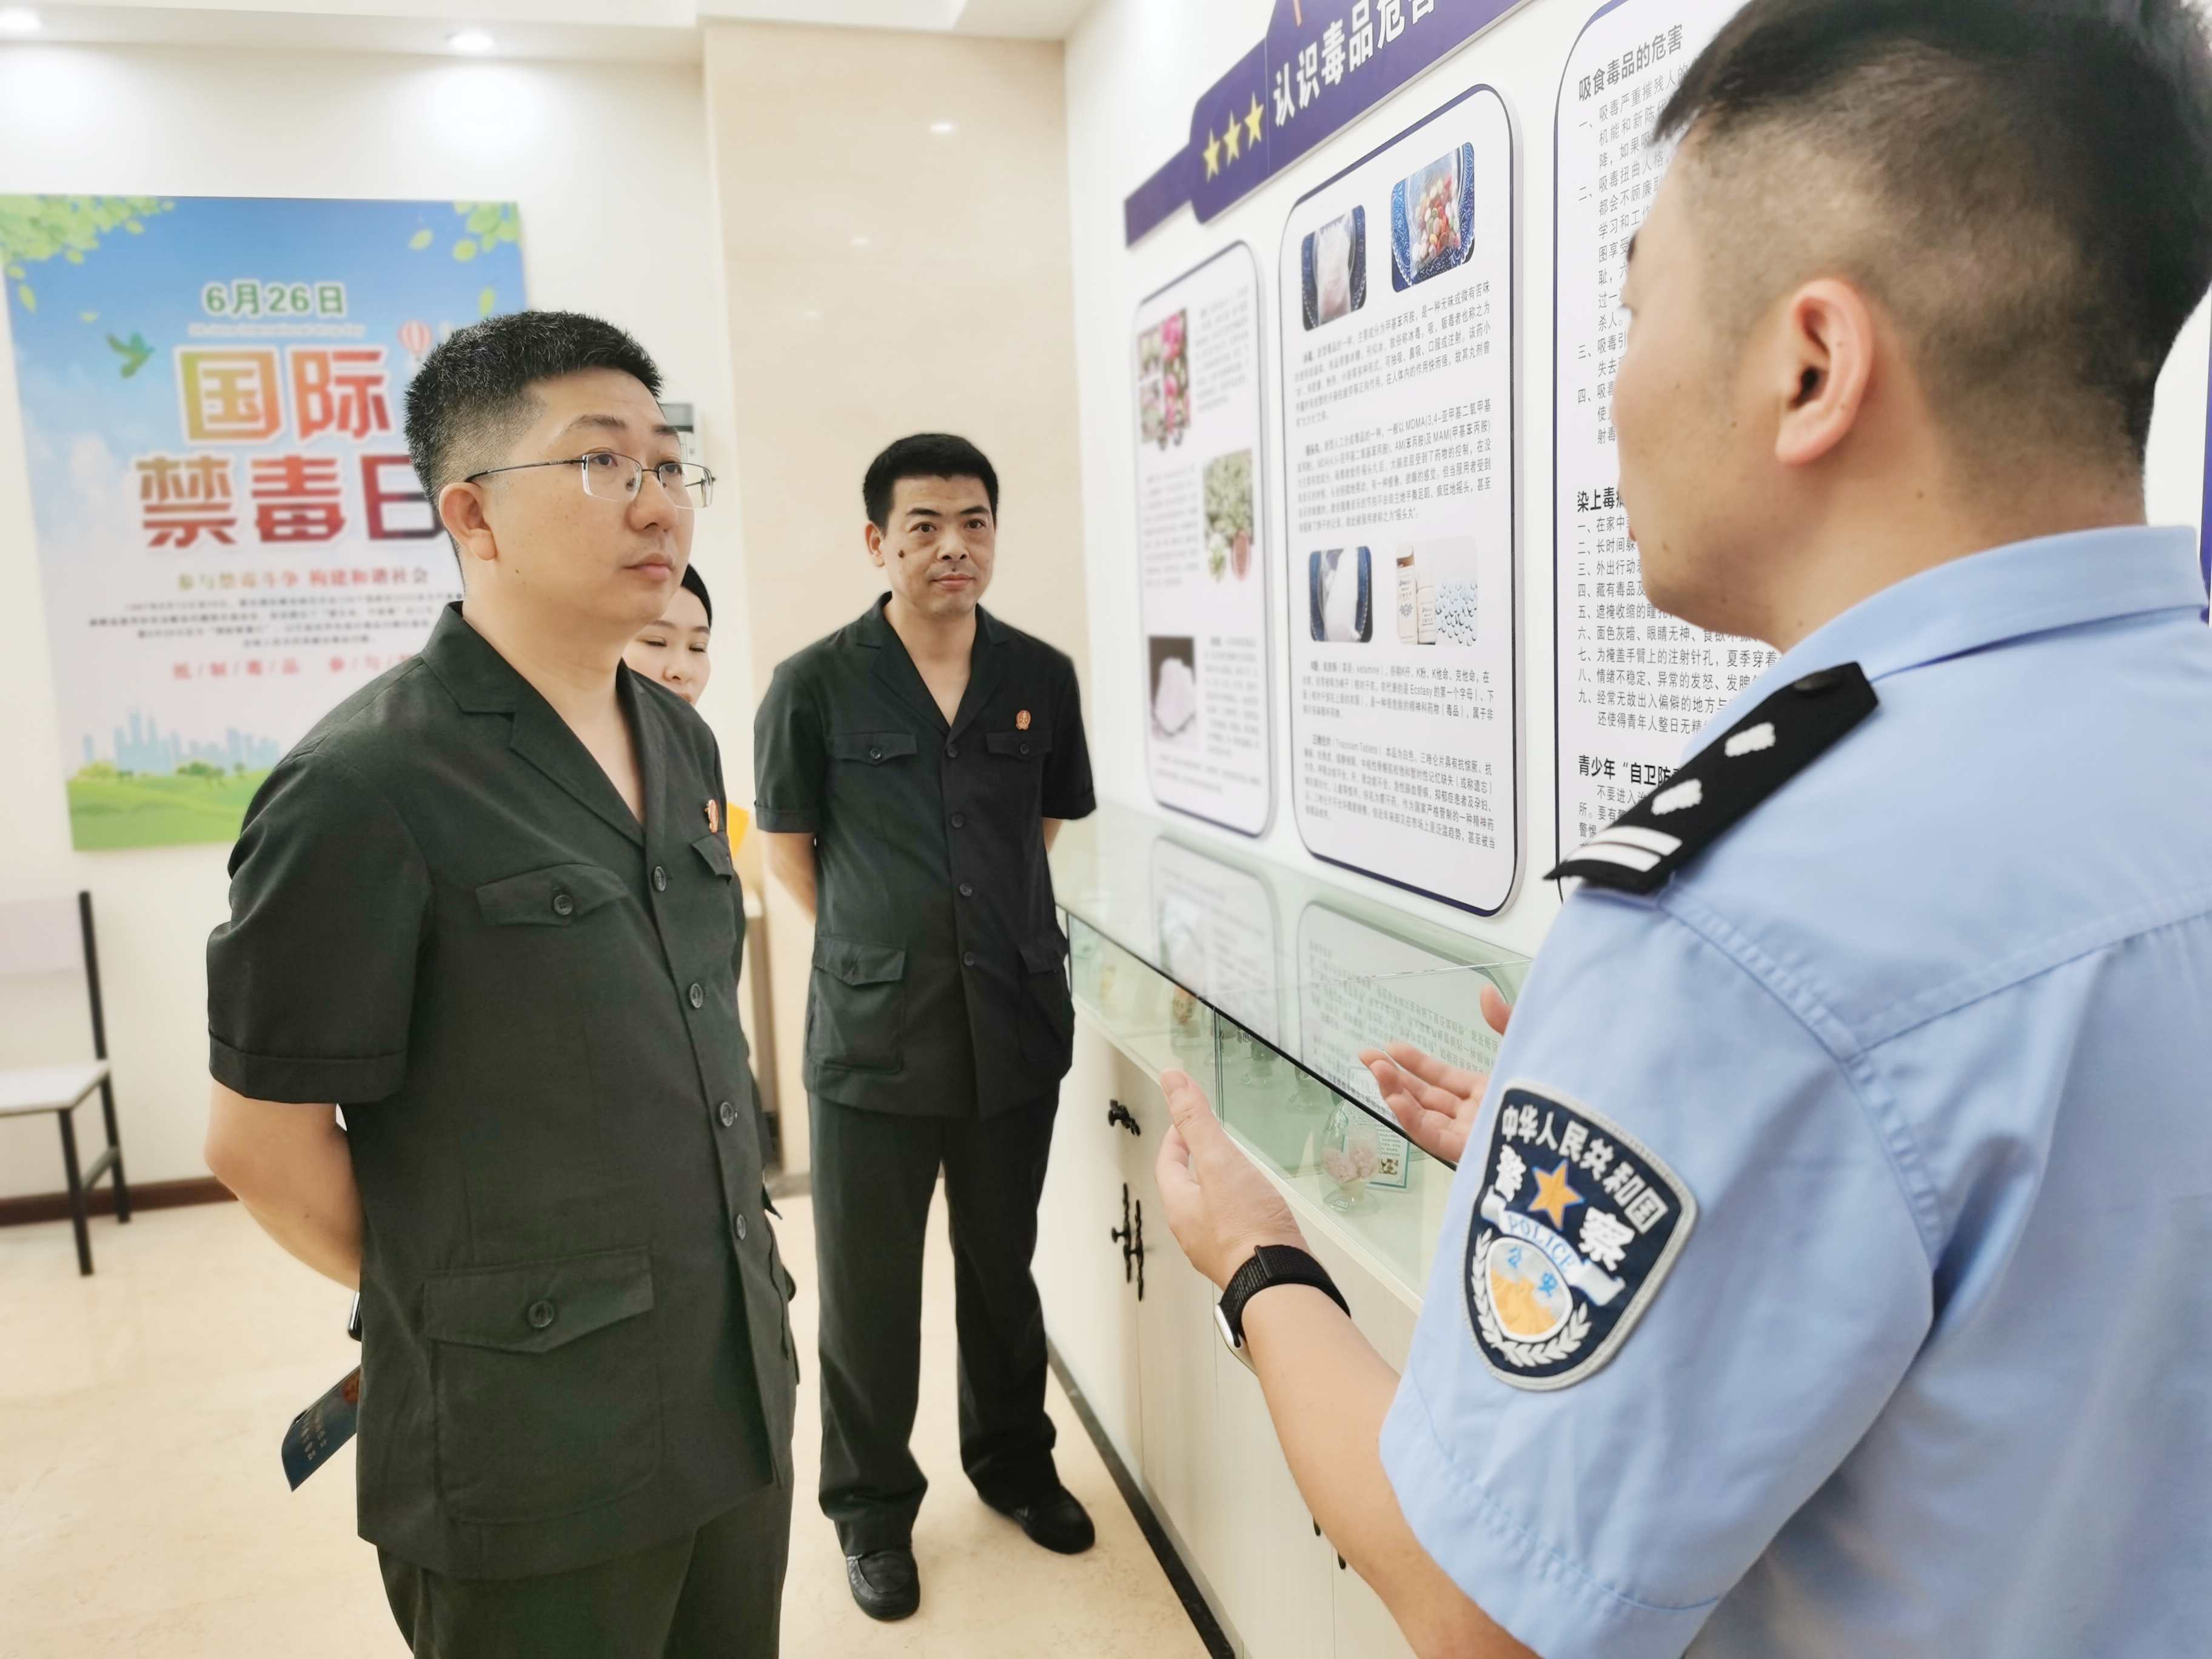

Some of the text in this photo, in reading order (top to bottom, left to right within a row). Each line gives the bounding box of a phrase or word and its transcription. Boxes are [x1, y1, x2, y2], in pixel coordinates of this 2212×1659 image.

[1578, 24, 1683, 102] 吸食毒品的危害
[206, 282, 344, 315] 6月26日
[1598, 311, 1623, 332] 杀人。
[1578, 330, 1627, 360] 三、吸毒引
[179, 350, 390, 440] 国际
[1598, 406, 1615, 424] 使
[1598, 426, 1616, 445] 射毒
[135, 455, 447, 548] 禁毒日
[1578, 514, 1631, 534] 一、在家中
[1578, 647, 1781, 668] 七、为掩盖手臂上的注射针孔，夏季穿着
[1410, 684, 1433, 699] Ecstasy
[1578, 688, 1732, 714] 九、经常无故出入偏僻的地方与
[1598, 712, 1708, 736] 还使得青年人整日无精
[1578, 754, 1680, 788] 青少年“自卫防
[1501, 1104, 1669, 1235] 中华人民共和国
[1495, 1144, 1636, 1272] 警 察
[1507, 1213, 1577, 1272] POLICE
